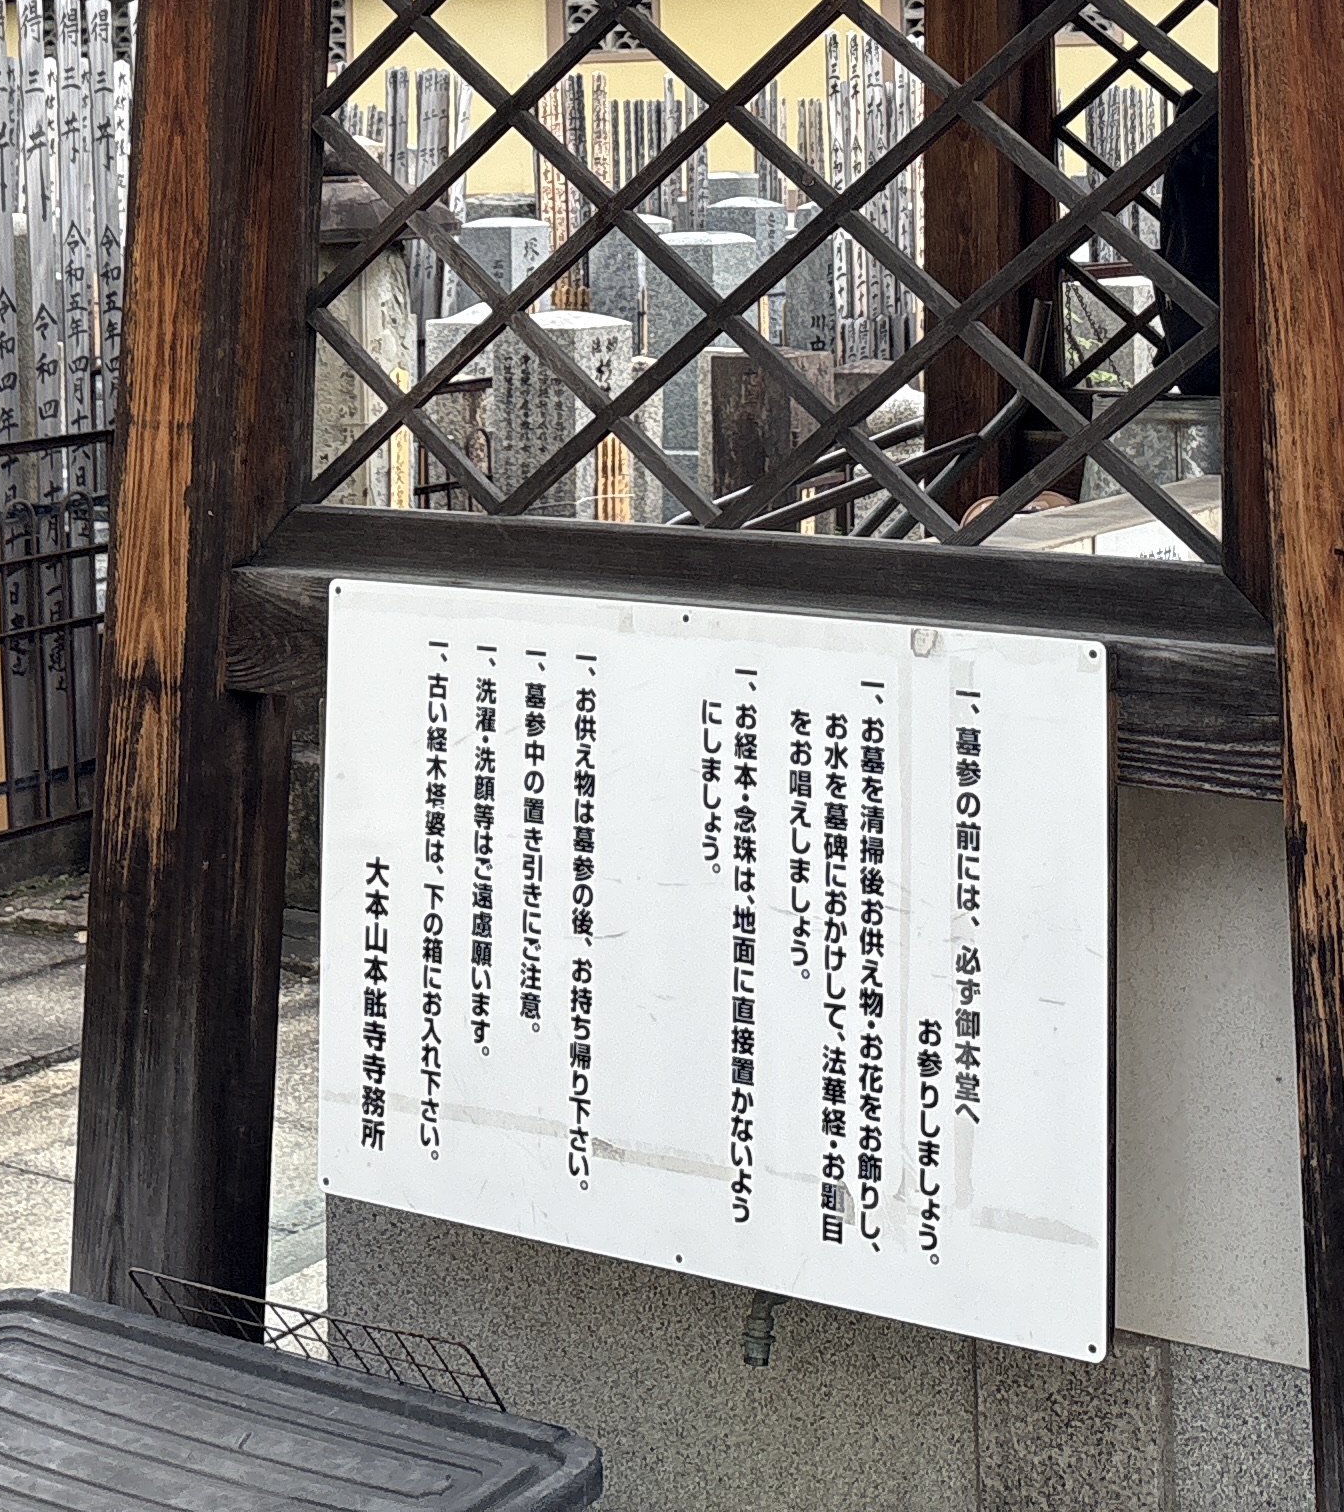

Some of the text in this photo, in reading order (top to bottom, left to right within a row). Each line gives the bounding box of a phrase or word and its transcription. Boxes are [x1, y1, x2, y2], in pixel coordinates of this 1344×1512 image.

[701, 699, 722, 875] にしましょう。
[789, 708, 813, 981] をお唱えしましょう。
[917, 1018, 943, 1266] お参りしましょう。
